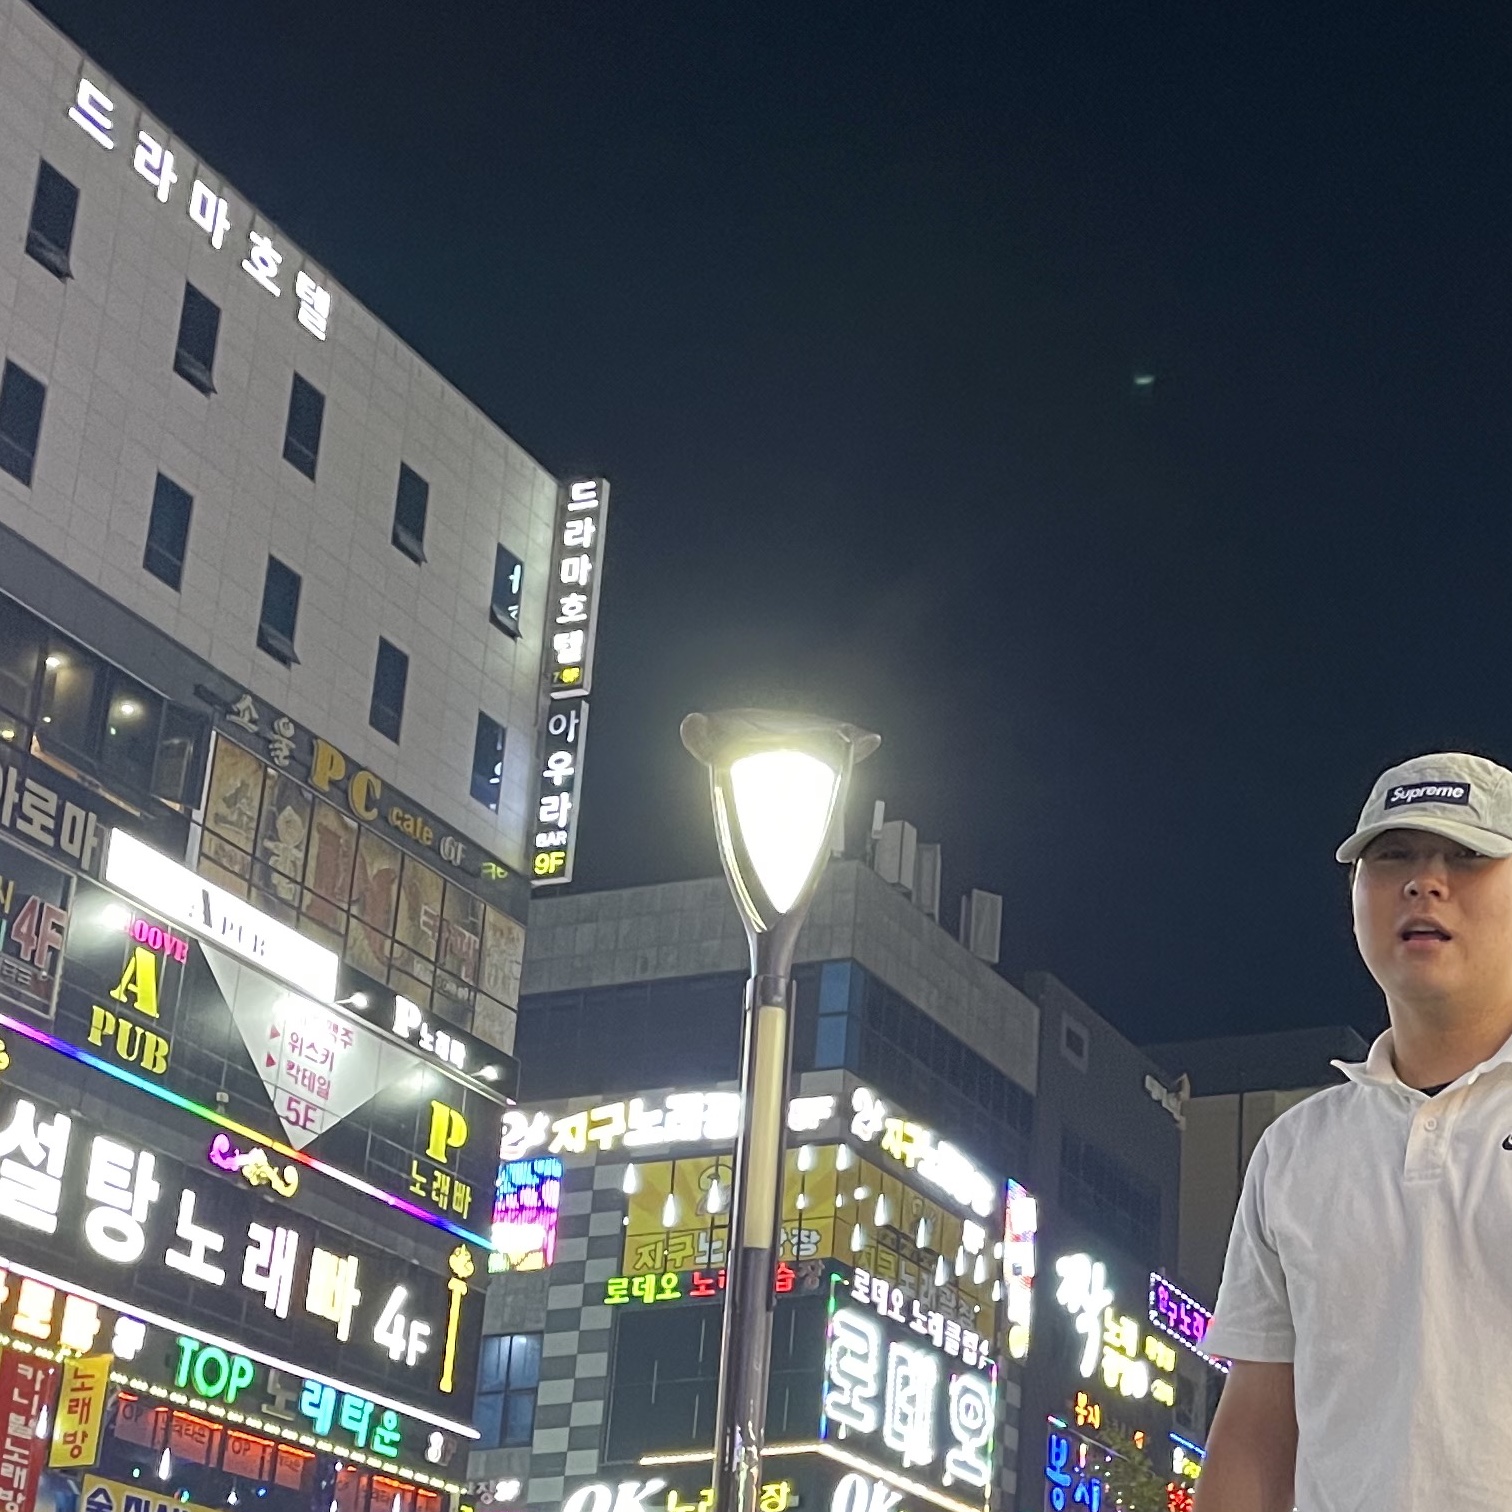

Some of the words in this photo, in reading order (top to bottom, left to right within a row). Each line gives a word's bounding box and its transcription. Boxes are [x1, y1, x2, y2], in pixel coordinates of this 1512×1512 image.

[68, 77, 332, 341] 드라마호텔
[552, 479, 600, 664] 드라마호텔
[308, 737, 383, 823] PC
[387, 804, 435, 846] cafe
[535, 709, 580, 828] 아우라
[1391, 786, 1465, 803] Supreme
[533, 850, 567, 877] 9F
[535, 829, 568, 849] BAR
[11, 895, 68, 968] 4F
[109, 946, 160, 1020] A
[86, 1004, 170, 1076] PUB
[286, 1031, 335, 1074] 위스키
[285, 1095, 318, 1132] 5F
[425, 1100, 469, 1164] P
[603, 1274, 684, 1306] 로데오
[850, 1266, 907, 1325] 로데오
[372, 1284, 432, 1367] 4F
[174, 1336, 255, 1404] TOP
[61, 1364, 96, 1461] 노래방
